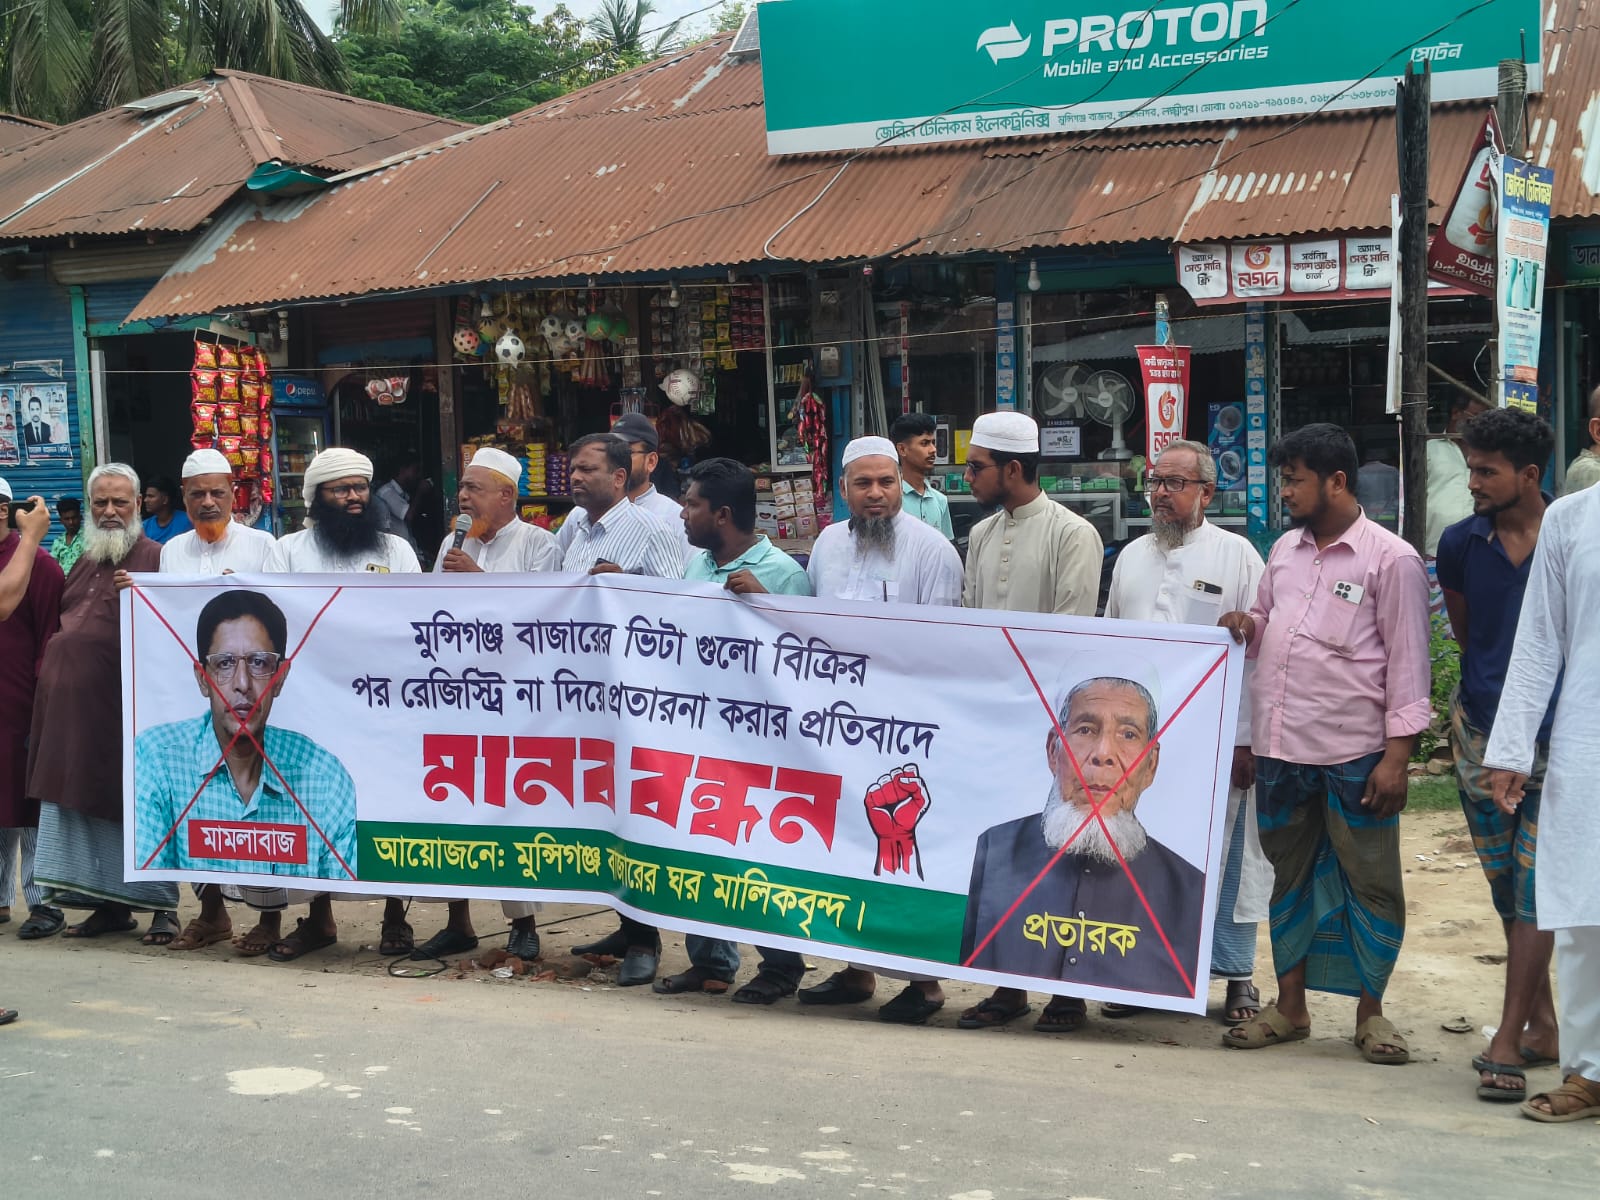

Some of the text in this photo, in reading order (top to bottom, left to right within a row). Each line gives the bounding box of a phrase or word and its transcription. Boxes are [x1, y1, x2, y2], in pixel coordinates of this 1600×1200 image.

[1042, 0, 1268, 57] PROTON
[1043, 45, 1269, 78] Mobile and Accessories
[920, 117, 972, 137] টেলিকম
[1349, 250, 1390, 264] সেন্ড মানি
[1357, 244, 1382, 253] অ্যাপে
[1237, 271, 1279, 288] নগদ
[1363, 263, 1379, 277] ফ্রি
[410, 610, 871, 688] মুন্সিগঞ্জ বাজারের ভিটা গুলো বিক্রির
[351, 667, 941, 759] পর রেজিস্ট্রি না দিয়ে প্রতারনা করার প্রতিবাদে
[200, 824, 297, 857] মামলাবাজ
[512, 832, 602, 881] মুন্সিগঞ্জ
[606, 847, 661, 896] বাজারের
[666, 865, 706, 904] ঘর
[712, 867, 852, 939] মালিকবৃন্দ
[1022, 911, 1142, 957] প্রতারক
